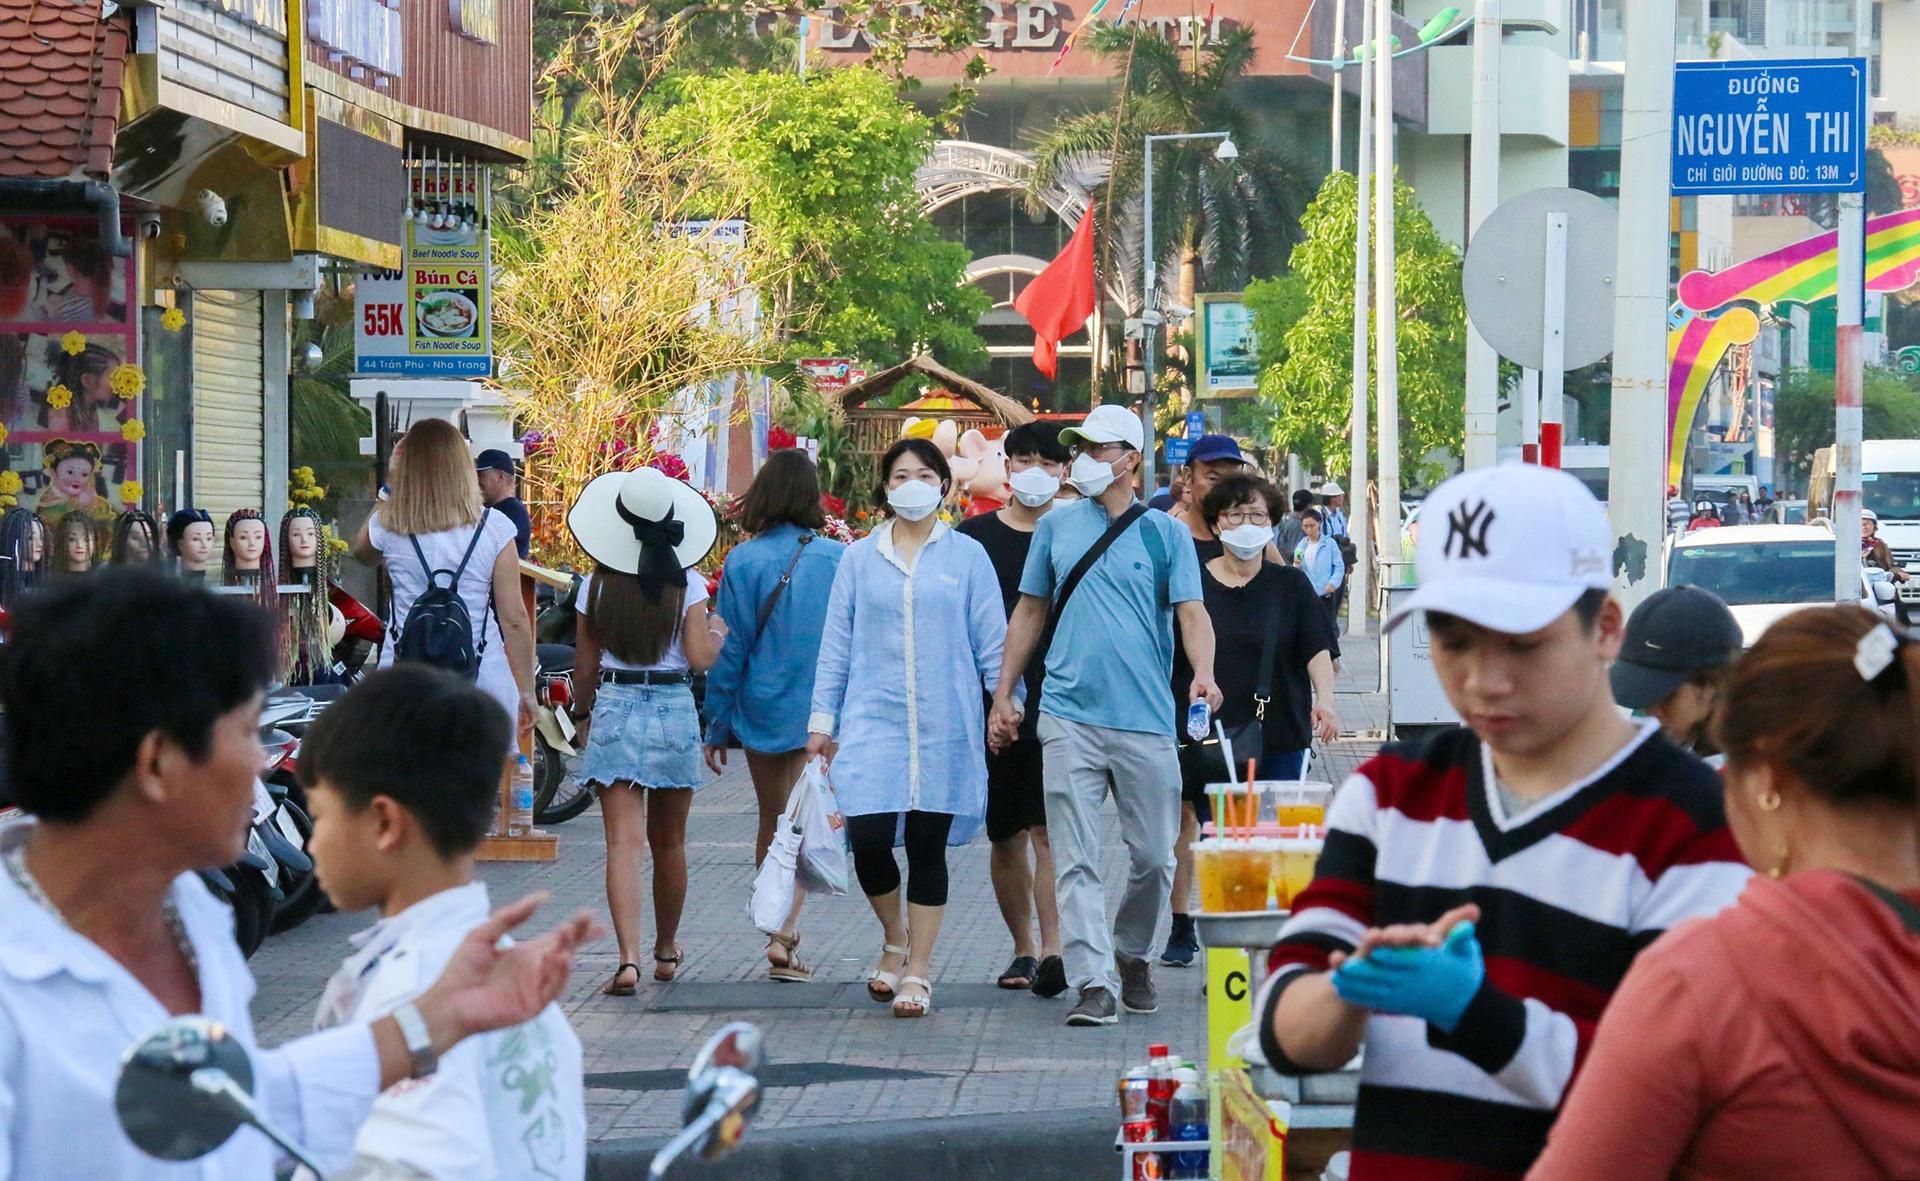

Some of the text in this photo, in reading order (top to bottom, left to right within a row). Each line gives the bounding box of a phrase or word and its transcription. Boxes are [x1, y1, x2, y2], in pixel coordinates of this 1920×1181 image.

[815, 0, 1059, 48] LGE
[1678, 96, 1850, 156] NGUYỄN THI
[1687, 162, 1707, 182] CHỈ
[1712, 163, 1737, 182] GIỚI
[1741, 162, 1783, 181] ĐƯỜNG
[1815, 165, 1839, 180] 13M
[412, 249, 480, 260] Beef Noodle Soup
[415, 269, 478, 285] Bún Cá
[364, 303, 404, 336] 55K
[415, 341, 481, 351] Fish Noodle Soup
[364, 360, 377, 368] 44
[433, 360, 454, 368] Nha
[457, 360, 486, 371] Trang
[1444, 500, 1495, 558] NY
